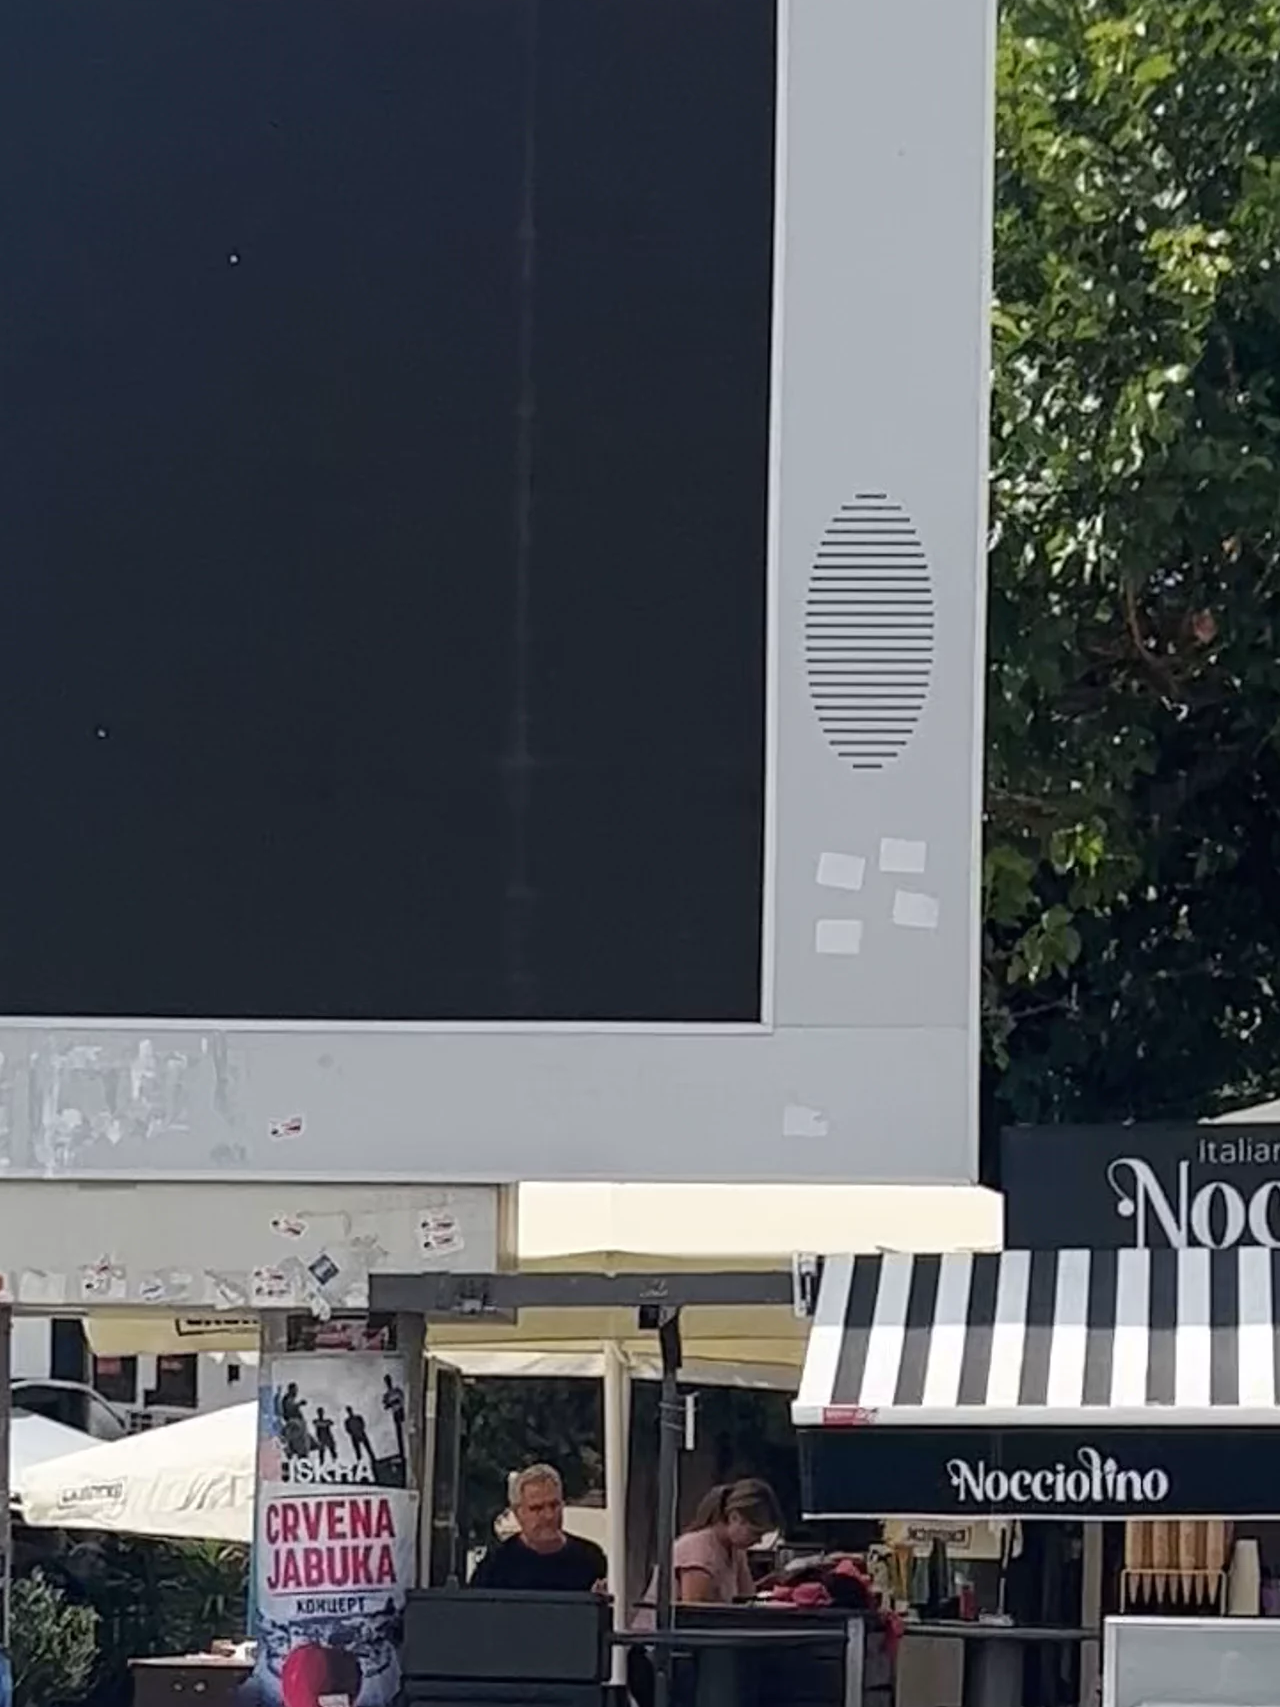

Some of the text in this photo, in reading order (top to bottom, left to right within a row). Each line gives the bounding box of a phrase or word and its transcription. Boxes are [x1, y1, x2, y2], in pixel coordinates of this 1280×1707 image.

[947, 1445, 1169, 1503] Nocciolino
[265, 1498, 396, 1544] CRVENA
[266, 1544, 397, 1590] JABUKA
[296, 1597, 366, 1618] КОНЦЕРТ
